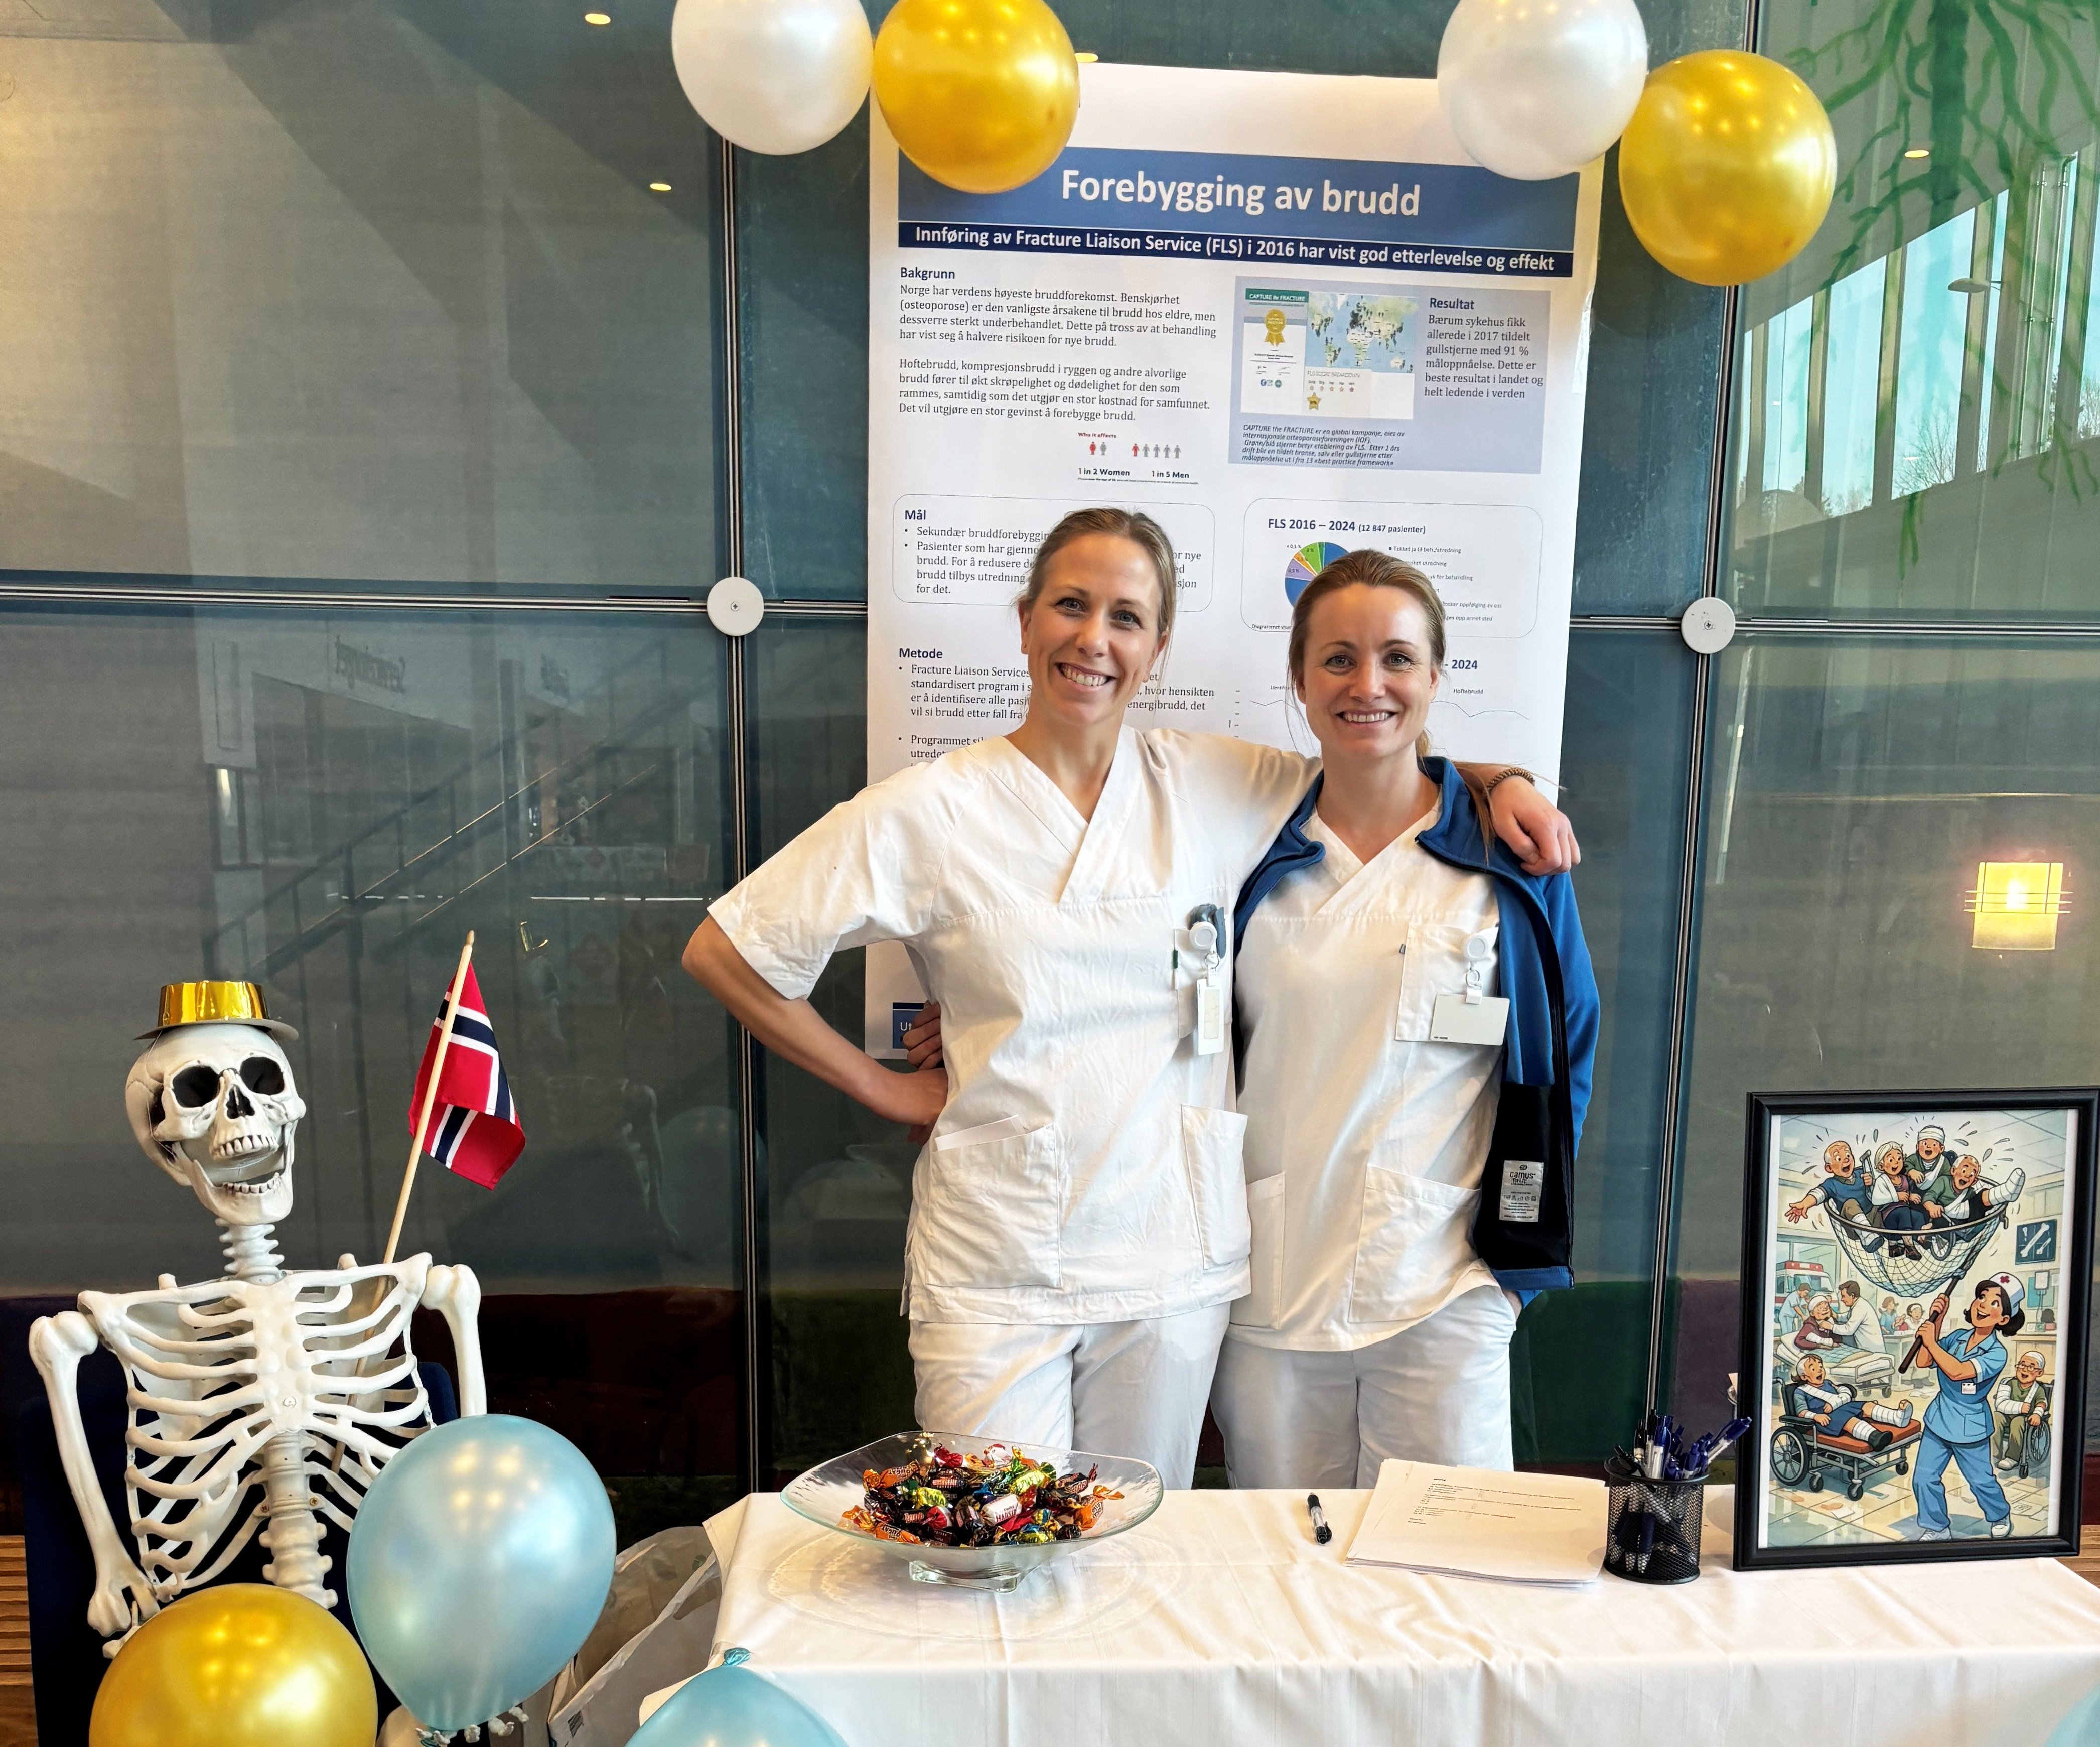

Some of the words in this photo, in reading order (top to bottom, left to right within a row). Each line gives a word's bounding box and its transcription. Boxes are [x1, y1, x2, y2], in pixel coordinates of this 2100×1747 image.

[1062, 169, 1266, 215] Forebygging
[1274, 186, 1313, 210] av
[1322, 179, 1420, 216] brudd
[916, 226, 989, 247] Innføring
[993, 232, 1012, 244] av
[1016, 230, 1081, 247] Fracture
[1086, 233, 1140, 250] Liaison
[1145, 235, 1202, 252] Service
[1206, 238, 1243, 258] (FLS)
[1247, 241, 1252, 254] i
[1256, 241, 1294, 257] 2016
[1299, 242, 1325, 258] har
[1328, 244, 1356, 260] vist
[1358, 246, 1388, 264] god
[1392, 248, 1482, 267] etterlevelse
[1486, 256, 1505, 272] og
[1509, 253, 1554, 270] effekt
[900, 266, 955, 281] Bakgrunn
[900, 284, 930, 297] Norge
[933, 284, 949, 295] har
[951, 286, 992, 297] verdens
[994, 287, 1032, 300] høyeste
[1035, 289, 1117, 302] bruddforekomst.
[1121, 292, 1180, 305] Benskjørhet
[900, 299, 968, 313] (osteoporose)
[985, 302, 1003, 312] den
[1006, 303, 1050, 316] vanligste
[1052, 304, 1097, 316] årsakene
[1099, 306, 1109, 317] til
[1112, 306, 1142, 317] brudd
[1145, 308, 1162, 318] hos
[1165, 309, 1192, 321] eldre,
[1195, 313, 1215, 321] men
[1429, 297, 1475, 310] Resultat
[1428, 314, 1463, 325] Bærum
[1465, 316, 1504, 328] sykehus
[1507, 317, 1525, 327] fikk
[899, 329, 917, 339] har
[918, 329, 937, 339] vist
[939, 332, 955, 342] seg
[958, 330, 963, 340] å
[966, 330, 1003, 341] halvere
[1005, 332, 1045, 343] risikoen
[1048, 333, 1062, 344] for
[1064, 337, 1082, 347] nye
[1084, 335, 1116, 346] brudd.
[1427, 329, 1466, 340] allerede
[1468, 331, 1471, 340] i
[1473, 331, 1499, 341] 2017
[1501, 331, 1530, 341] tildelt
[1426, 344, 1478, 356] gullstjerne
[1480, 345, 1501, 355] med
[1503, 345, 1515, 355] 91
[1519, 346, 1529, 356] %
[899, 358, 958, 370] Hoftebrudd,
[961, 360, 1055, 373] kompresjonsbrudd
[1058, 364, 1060, 373] i
[1063, 366, 1096, 377] ryggen
[1099, 368, 1111, 378] og
[1113, 366, 1142, 376] andre
[1144, 367, 1186, 381] alvorlige
[1426, 358, 1495, 371] måloppnåelse.
[1497, 360, 1523, 370] Dette
[1425, 372, 1451, 382] beste
[1453, 373, 1490, 383] resultat
[1493, 374, 1495, 383] i
[1498, 373, 1529, 384] landet
[1531, 377, 1543, 386] og
[1424, 386, 1443, 396] helt
[1445, 386, 1484, 397] ledende
[1486, 388, 1489, 397] i
[1491, 388, 1525, 398] verden
[899, 402, 916, 412] Det
[918, 402, 930, 413] vil
[933, 404, 968, 416] utgjøre
[985, 407, 1005, 416] stor
[1007, 407, 1043, 418] gevinst
[1044, 407, 1050, 417] å
[1053, 407, 1101, 421] forebygge
[1103, 409, 1135, 420] brudd.
[905, 509, 926, 520] Mål
[916, 526, 966, 537] Sekundær
[1268, 518, 1286, 529] FLS
[1289, 519, 1316, 530] 2016
[1328, 520, 1355, 531] 2024
[1358, 523, 1370, 533] (12
[1387, 525, 1425, 534] pasienter)
[917, 541, 963, 551] Pasienter
[988, 543, 1005, 553] har
[917, 555, 948, 565] brudd.
[951, 556, 967, 566] For
[970, 556, 975, 566] å
[978, 557, 1021, 568] redusere
[1185, 552, 1201, 562] nye
[916, 569, 946, 579] brudd
[949, 570, 975, 582] tilbys
[978, 572, 1026, 585] utredning
[916, 583, 930, 593] for
[933, 584, 950, 594] det.
[899, 648, 942, 658] Metode
[911, 664, 951, 674] Fracture
[954, 665, 988, 676] Liaison
[1451, 659, 1478, 669] 2024
[911, 679, 975, 689] standardisert
[978, 683, 1019, 693] program
[1022, 682, 1024, 691] i
[1145, 685, 1166, 695] hvor
[1168, 686, 1214, 696] hensikten
[923, 692, 928, 702] å
[931, 693, 986, 704] identifisere
[988, 695, 1005, 704] alle
[1127, 699, 1188, 711] energibrudd,
[1190, 700, 1205, 710] det
[910, 706, 922, 716] vil
[925, 707, 932, 716] si
[935, 707, 964, 717] brudd
[967, 709, 990, 718] etter
[993, 709, 1007, 718] fall
[1010, 709, 1022, 719] fra
[911, 734, 970, 746] Programmet
